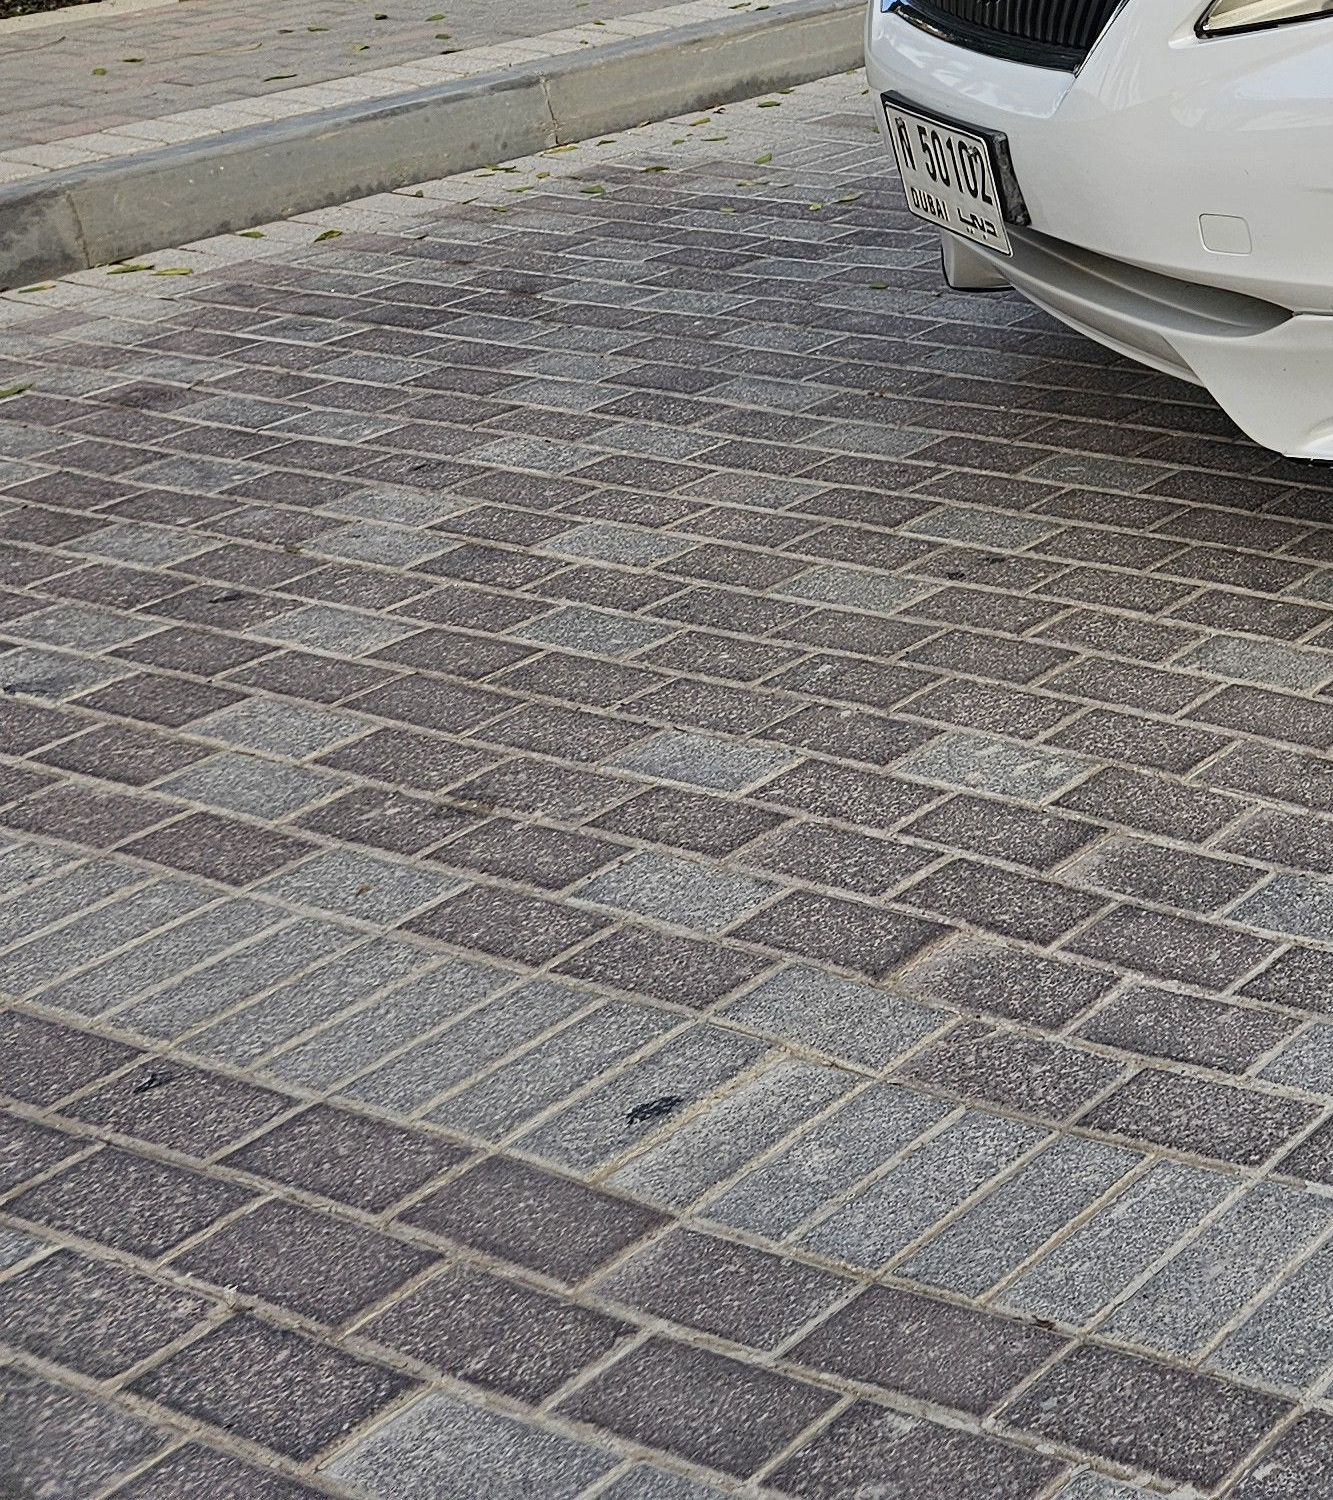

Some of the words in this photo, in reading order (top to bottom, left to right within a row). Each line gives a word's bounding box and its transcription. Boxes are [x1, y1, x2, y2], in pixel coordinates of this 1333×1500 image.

[894, 117, 916, 171] N
[917, 124, 993, 206] 50102
[910, 187, 951, 222] DUBAI
[957, 207, 998, 240] دبي
